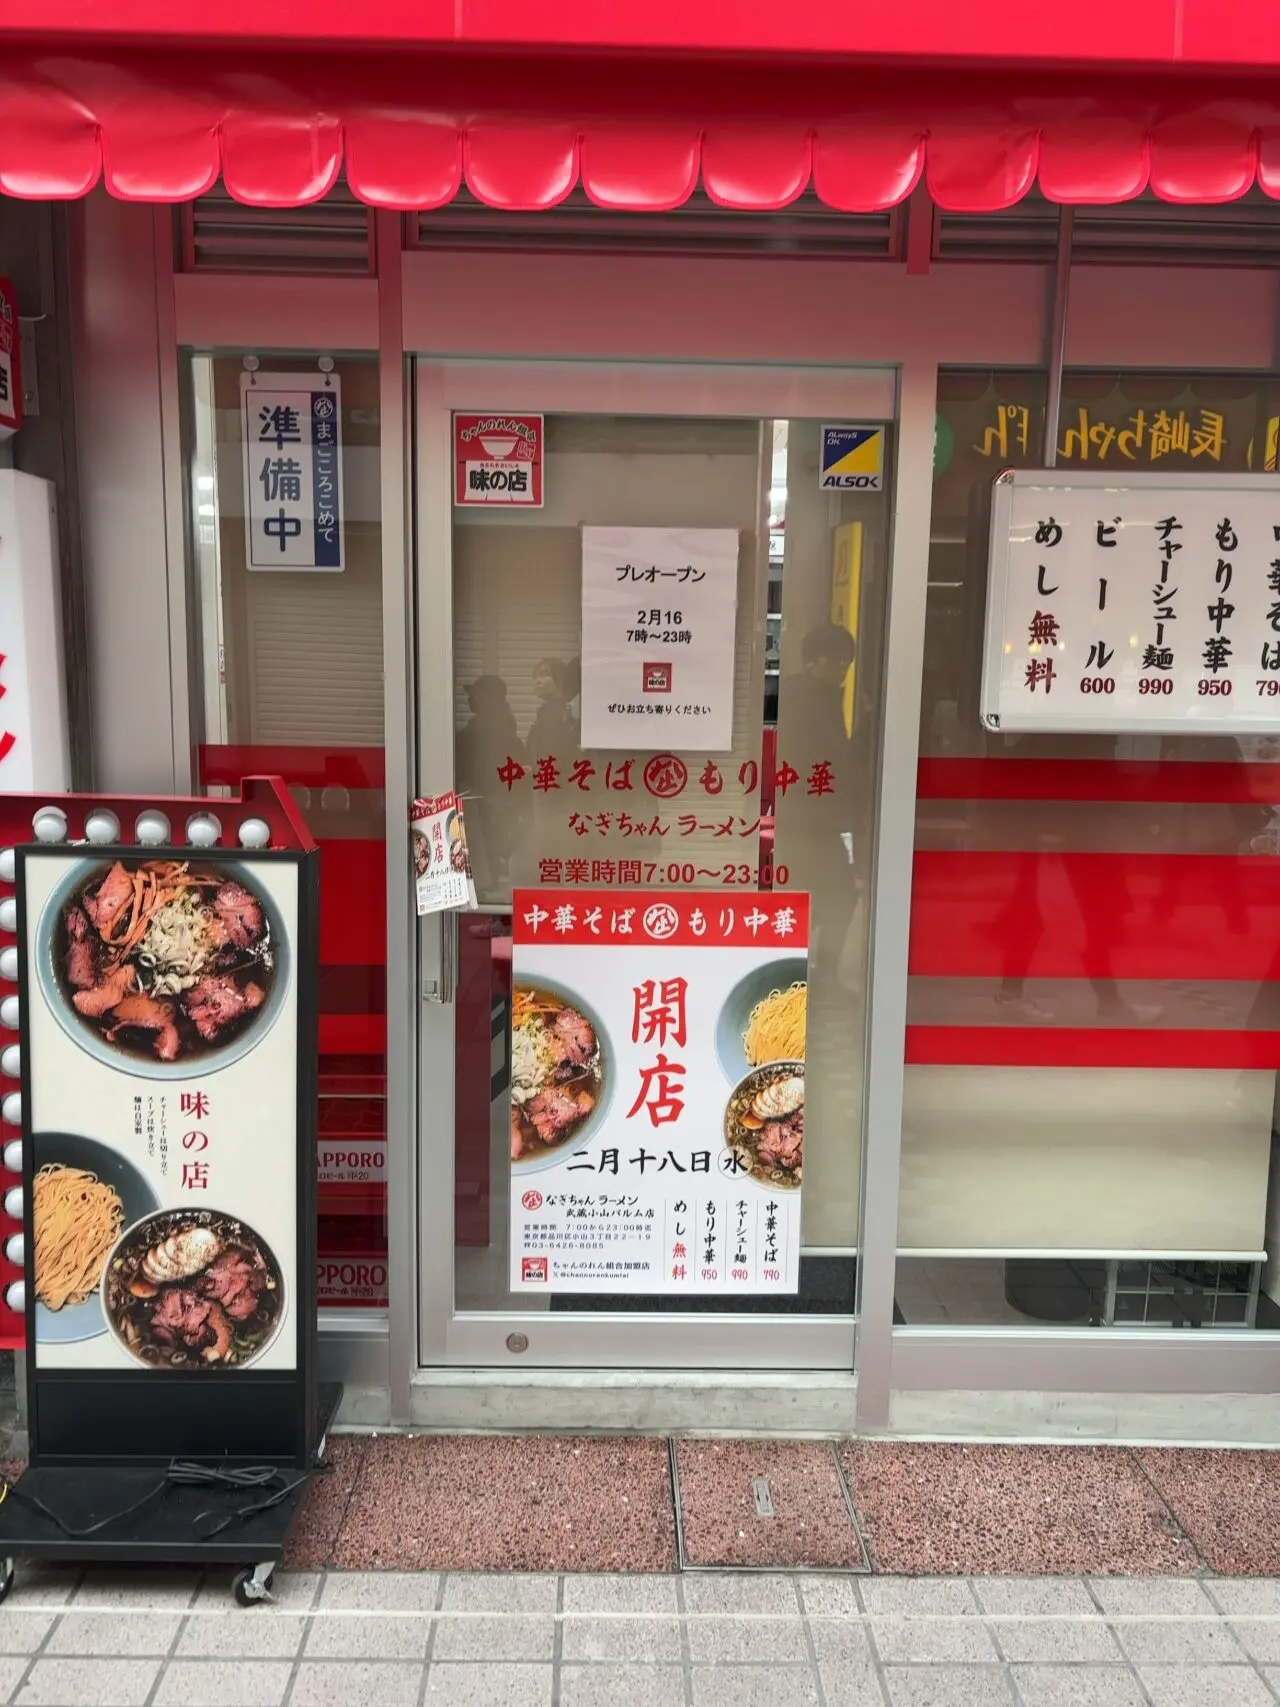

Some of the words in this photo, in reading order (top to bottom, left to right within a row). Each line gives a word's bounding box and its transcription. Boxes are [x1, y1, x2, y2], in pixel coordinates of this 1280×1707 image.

[258, 405, 302, 552] 準備中
[316, 422, 335, 543] まごころこめて
[470, 469, 527, 491] 味の店
[823, 476, 879, 488] ALSOK
[616, 564, 706, 583] プレオープン
[1085, 517, 1122, 670] ビール
[1142, 517, 1183, 671] チャーシュー麺
[1202, 518, 1238, 673] もり中華
[1024, 517, 1063, 694] めし無料
[637, 610, 682, 625] 2月16
[627, 630, 692, 644] 7時〜23時
[1080, 678, 1115, 694] 600
[1138, 678, 1173, 694] 990
[1197, 679, 1232, 696] 950
[1256, 680, 1280, 696] 79
[608, 704, 711, 715] ぜひお立ち寄りください
[497, 756, 635, 793] 中華そば
[699, 760, 835, 797] もり中華
[568, 812, 671, 837] なぎちゃん
[677, 814, 761, 837] ラーメン
[524, 904, 636, 935] 中華そば
[688, 907, 797, 937] もり中華
[626, 976, 688, 1128] 開店
[180, 1091, 210, 1189] 味の店
[546, 1194, 595, 1206] なぎちゃん
[599, 1194, 638, 1206] ラーメン
[672, 1200, 687, 1280] めし無料
[703, 1200, 716, 1264] もり中華
[765, 1201, 778, 1262] 中華そば
[702, 1269, 717, 1280] 950
[732, 1269, 748, 1280] 990
[763, 1269, 780, 1280] 790
